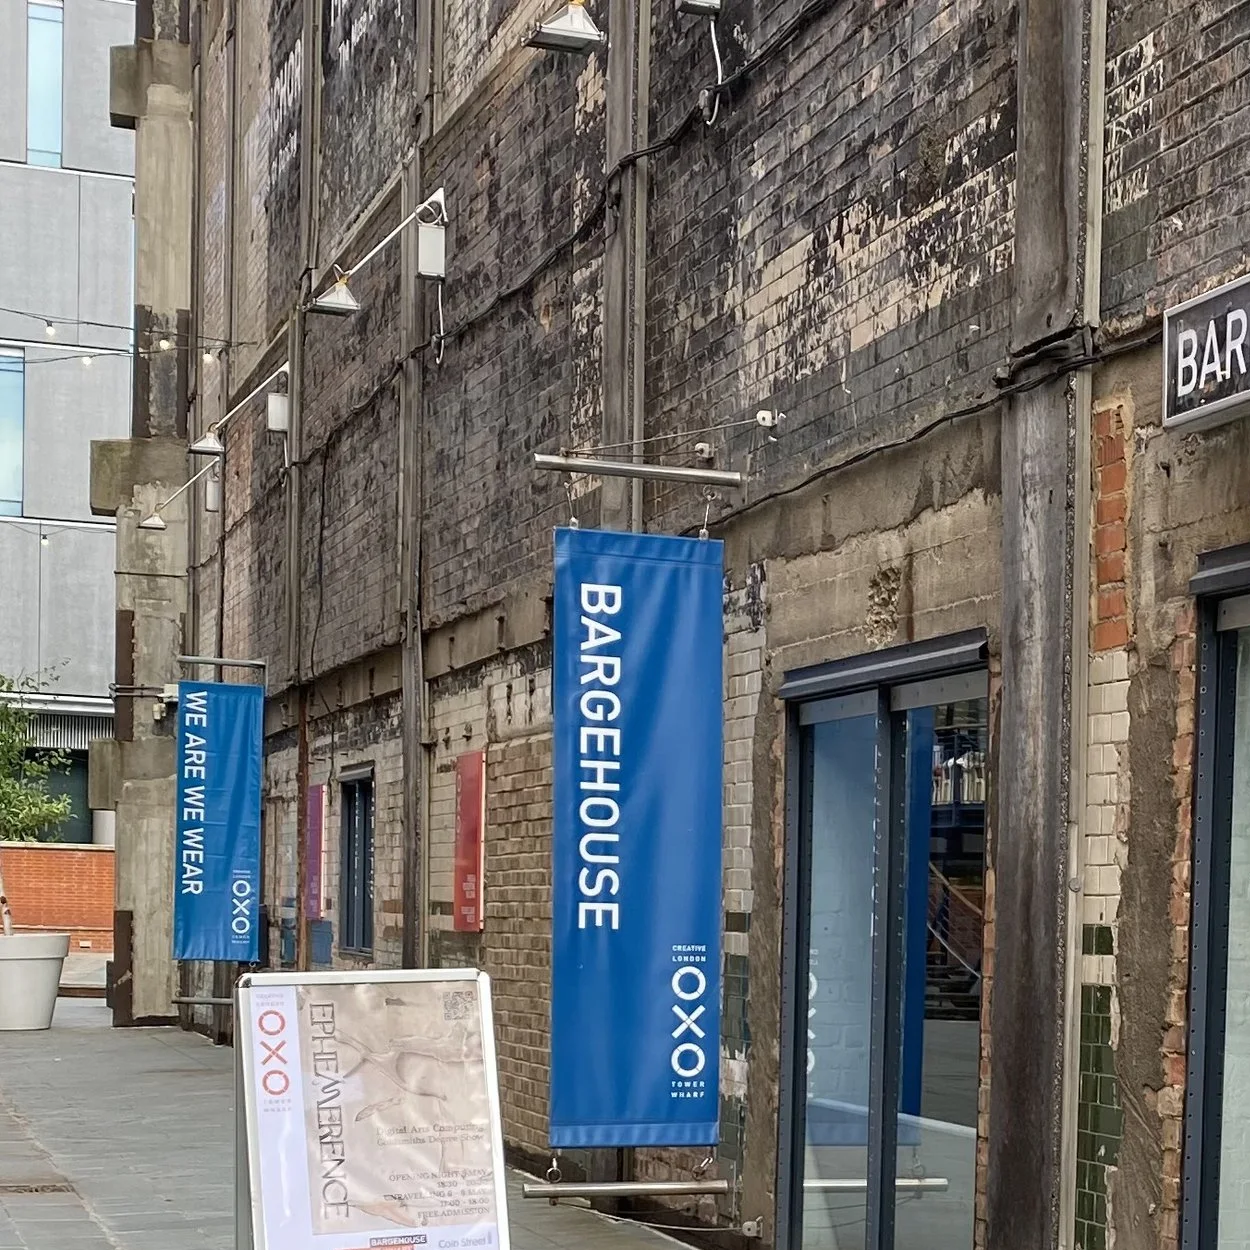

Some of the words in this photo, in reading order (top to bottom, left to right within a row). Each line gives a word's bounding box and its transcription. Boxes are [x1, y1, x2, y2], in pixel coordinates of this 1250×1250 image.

[185, 690, 208, 728] WE
[184, 732, 207, 780] ARE
[578, 582, 622, 930] BARGEHOUSE
[183, 785, 205, 822] WE
[181, 827, 204, 895] WEAR
[231, 880, 251, 934] OXO
[671, 966, 706, 1077] OXO
[371, 1235, 426, 1247] BARGEHOUSE
[438, 1239, 460, 1249] Coin
